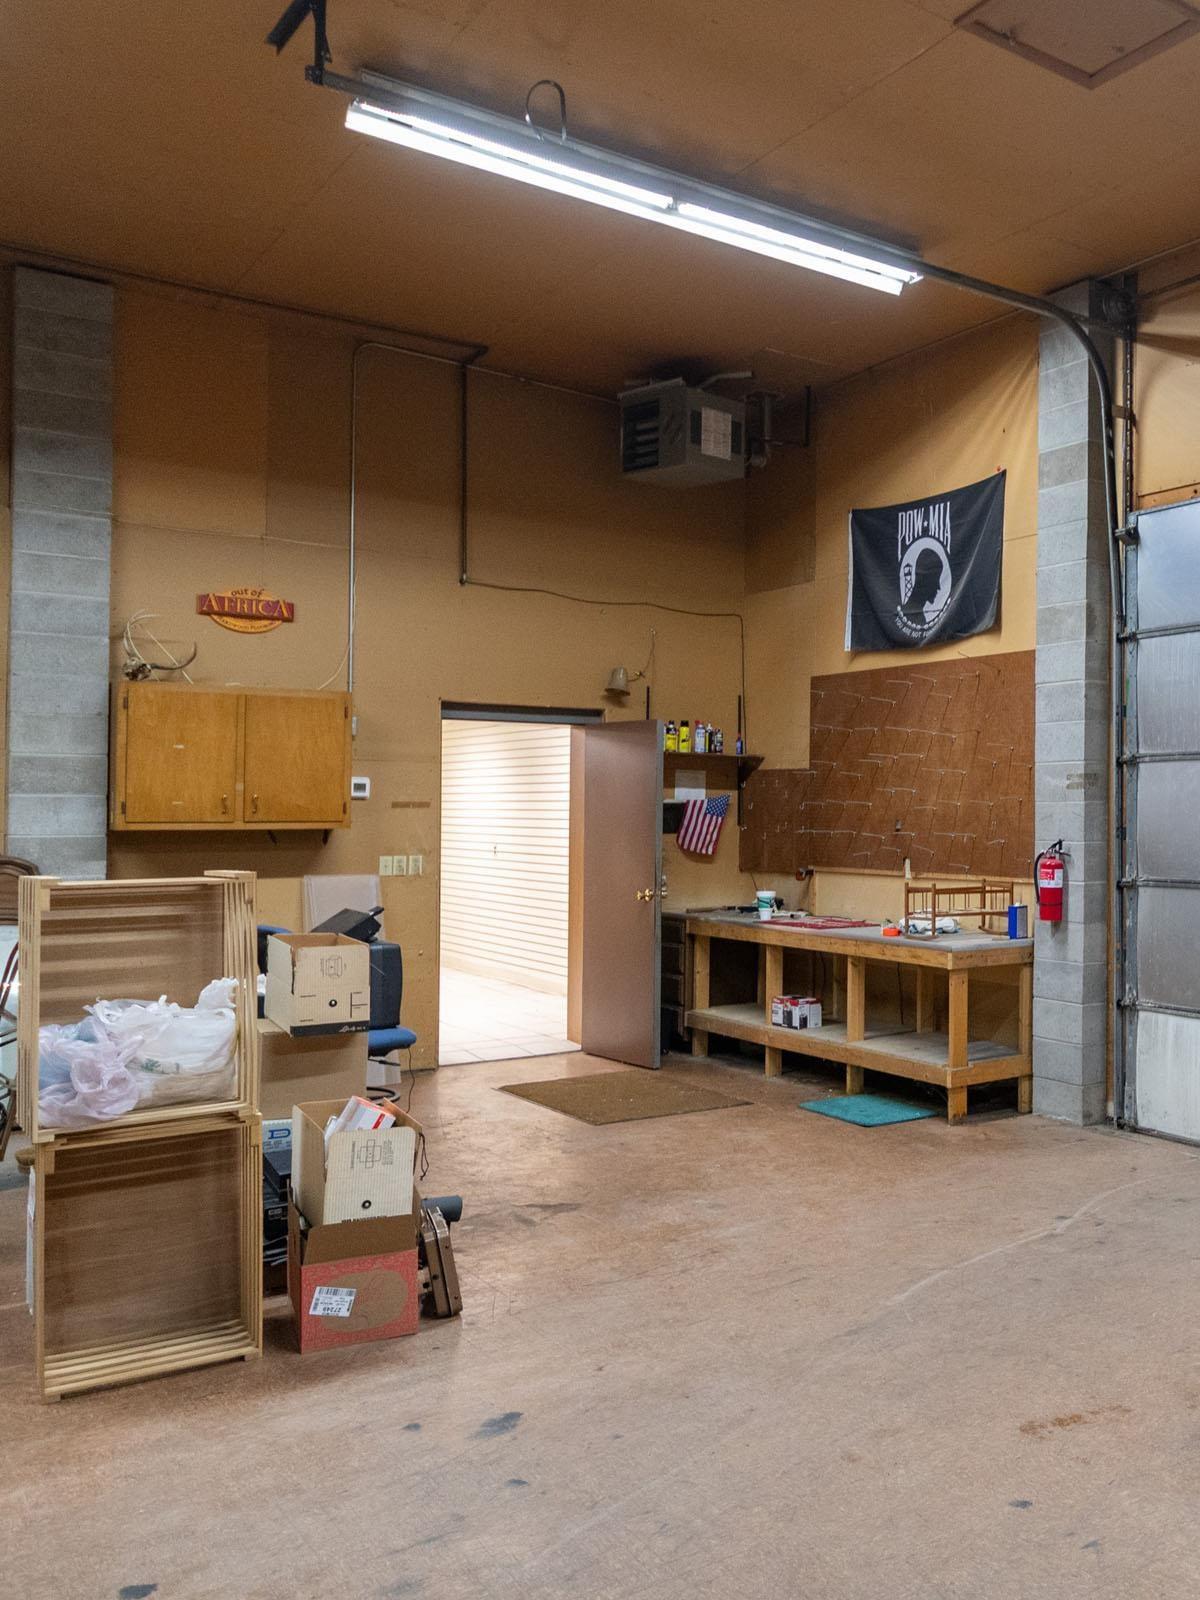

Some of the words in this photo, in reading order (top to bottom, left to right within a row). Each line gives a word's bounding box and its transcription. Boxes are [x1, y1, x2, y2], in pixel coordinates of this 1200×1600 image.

[898, 507, 924, 562] POW
[929, 501, 951, 554] MIA
[202, 593, 289, 618] AFRICA
[231, 588, 249, 597] out
[250, 588, 265, 598] of
